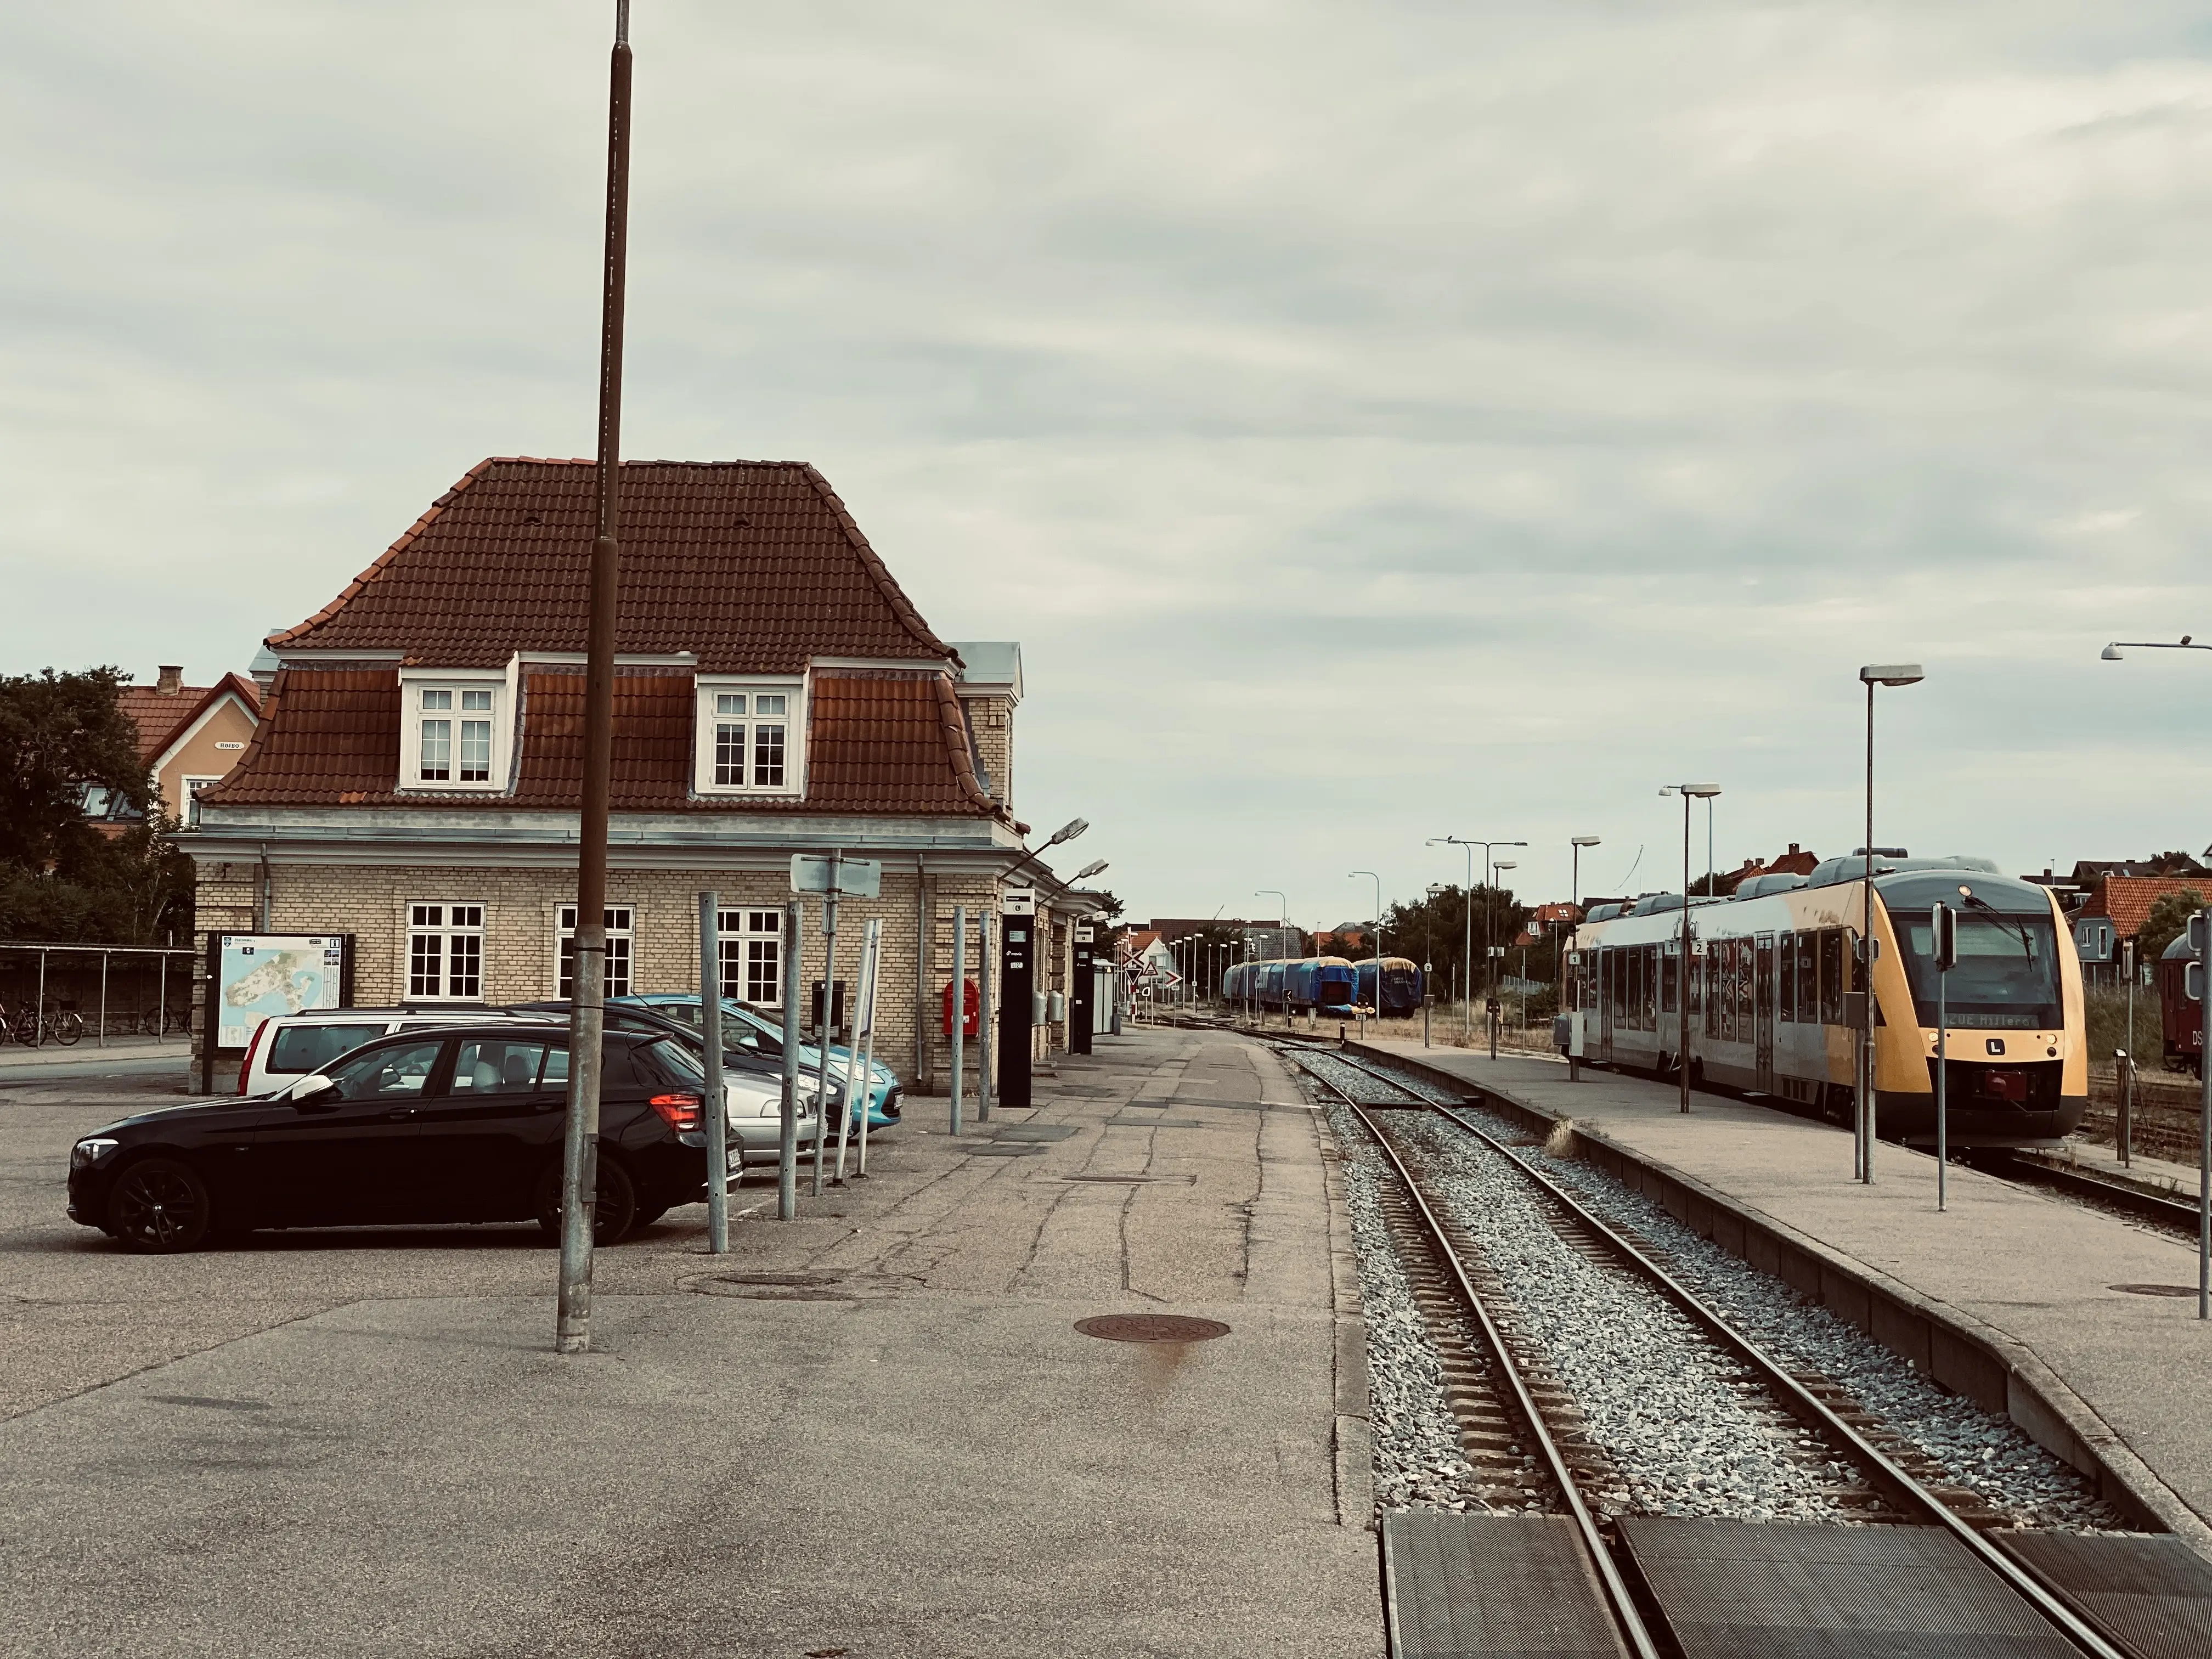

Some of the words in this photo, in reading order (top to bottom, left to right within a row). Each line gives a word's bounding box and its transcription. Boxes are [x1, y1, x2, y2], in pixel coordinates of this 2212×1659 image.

[1669, 944, 1673, 953] 1
[1696, 944, 1702, 953] 2
[1990, 1041, 2001, 1053] L
